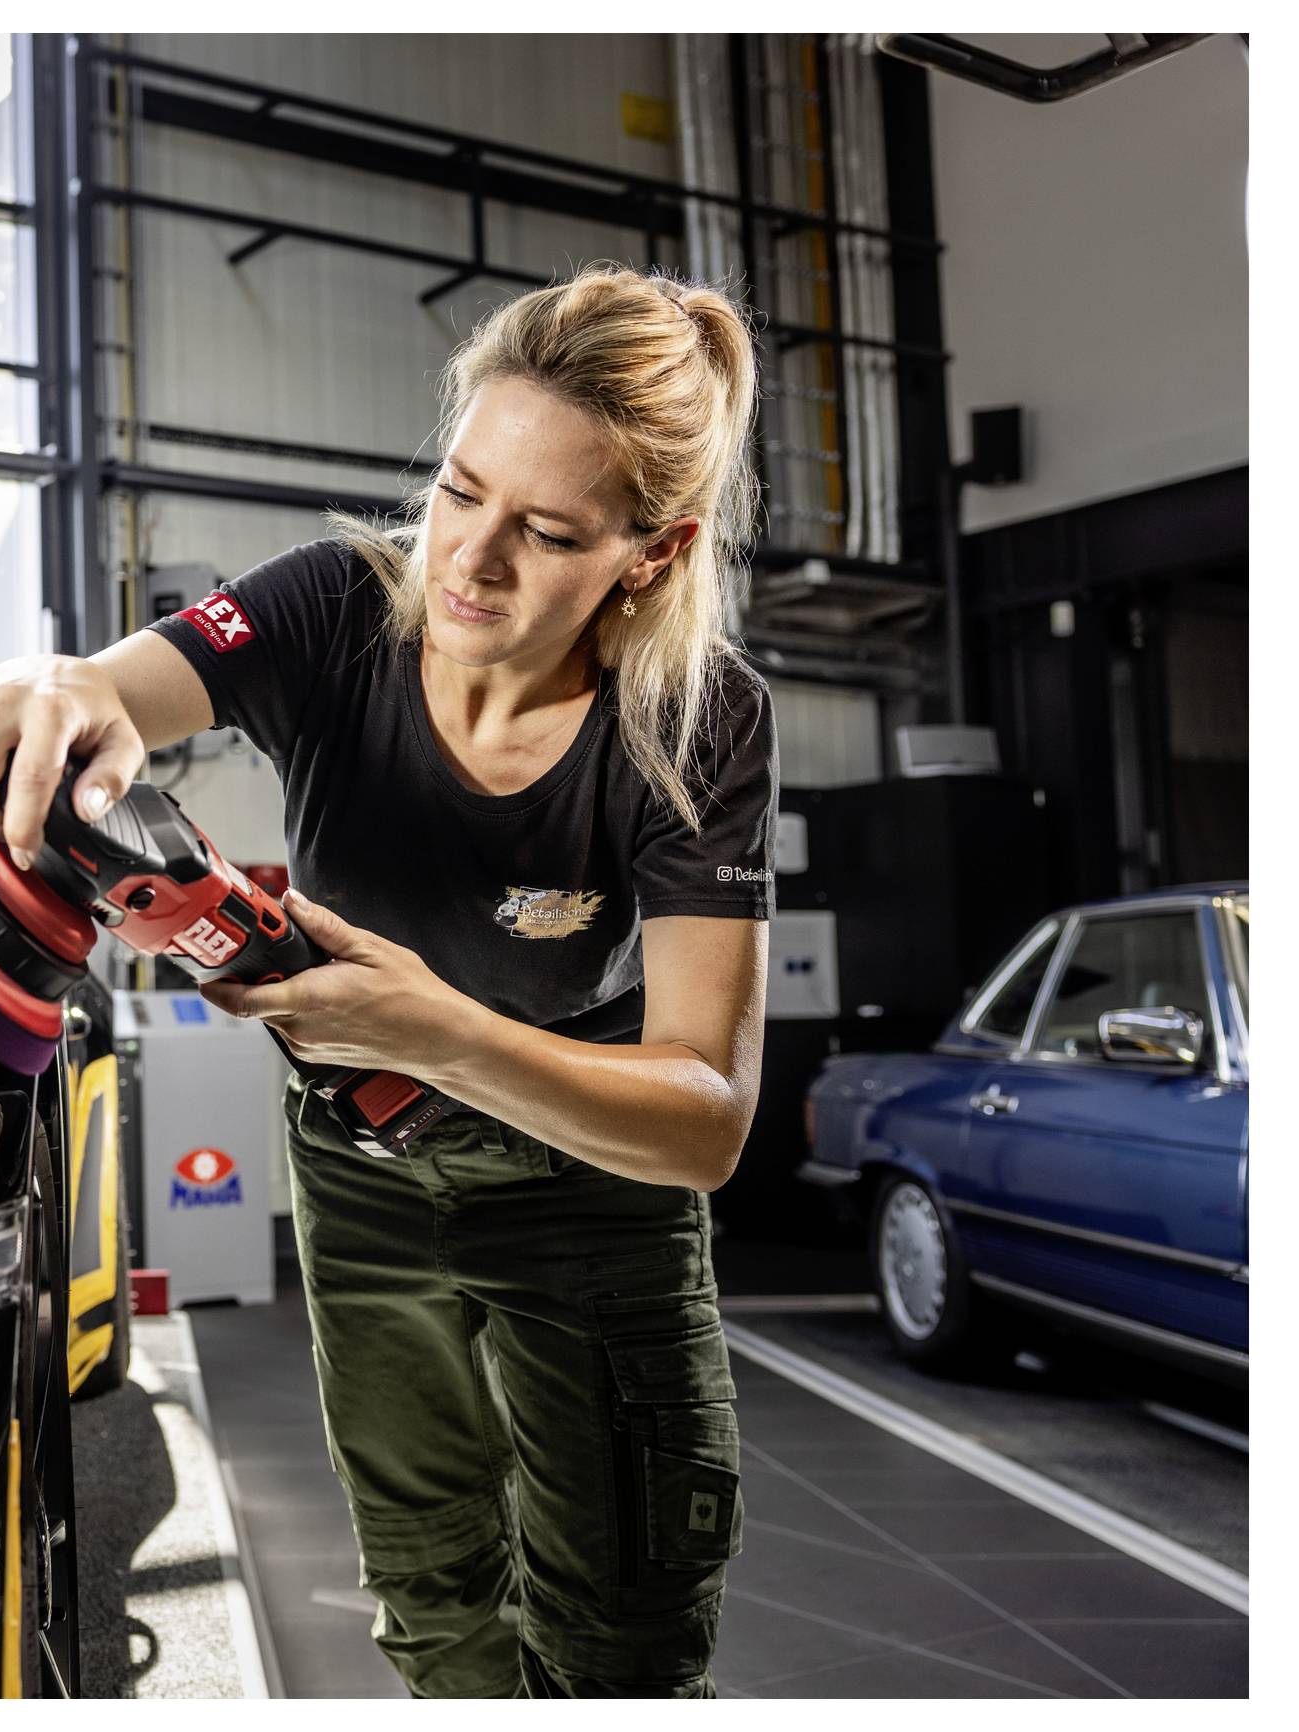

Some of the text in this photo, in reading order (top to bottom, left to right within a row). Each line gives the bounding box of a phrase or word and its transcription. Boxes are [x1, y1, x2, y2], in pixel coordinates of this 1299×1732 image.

[194, 595, 251, 643] LEX
[203, 622, 227, 648] Original
[184, 916, 239, 961] FLEX
